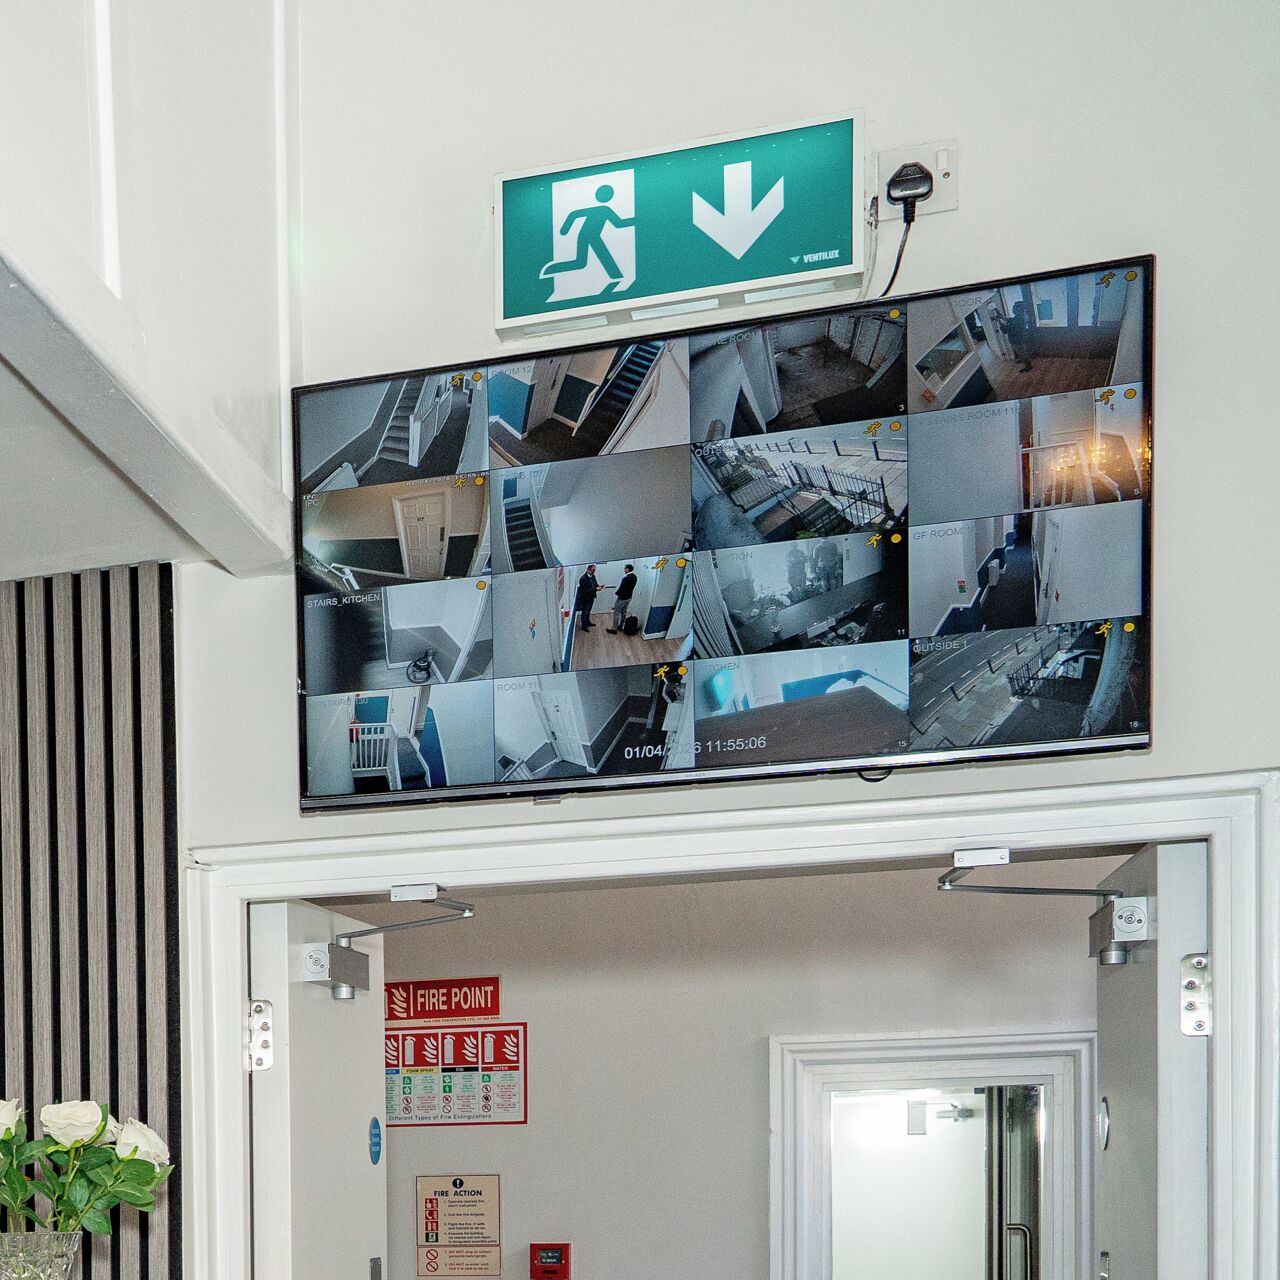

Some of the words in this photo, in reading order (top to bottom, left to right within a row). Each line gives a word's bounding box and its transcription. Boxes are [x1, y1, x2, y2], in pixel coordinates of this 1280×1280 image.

[803, 249, 840, 263] VENTILUX
[967, 408, 1001, 421] ROOM
[912, 531, 927, 541] GF
[306, 593, 381, 609] STAIRS_KITCHEN
[912, 640, 960, 654] OUTSIDE
[496, 681, 526, 692] ROOM
[705, 736, 767, 753] 11:55:06
[417, 988, 448, 1011] FIRE
[451, 985, 494, 1010] POINT
[453, 1189, 482, 1197] ACTION
